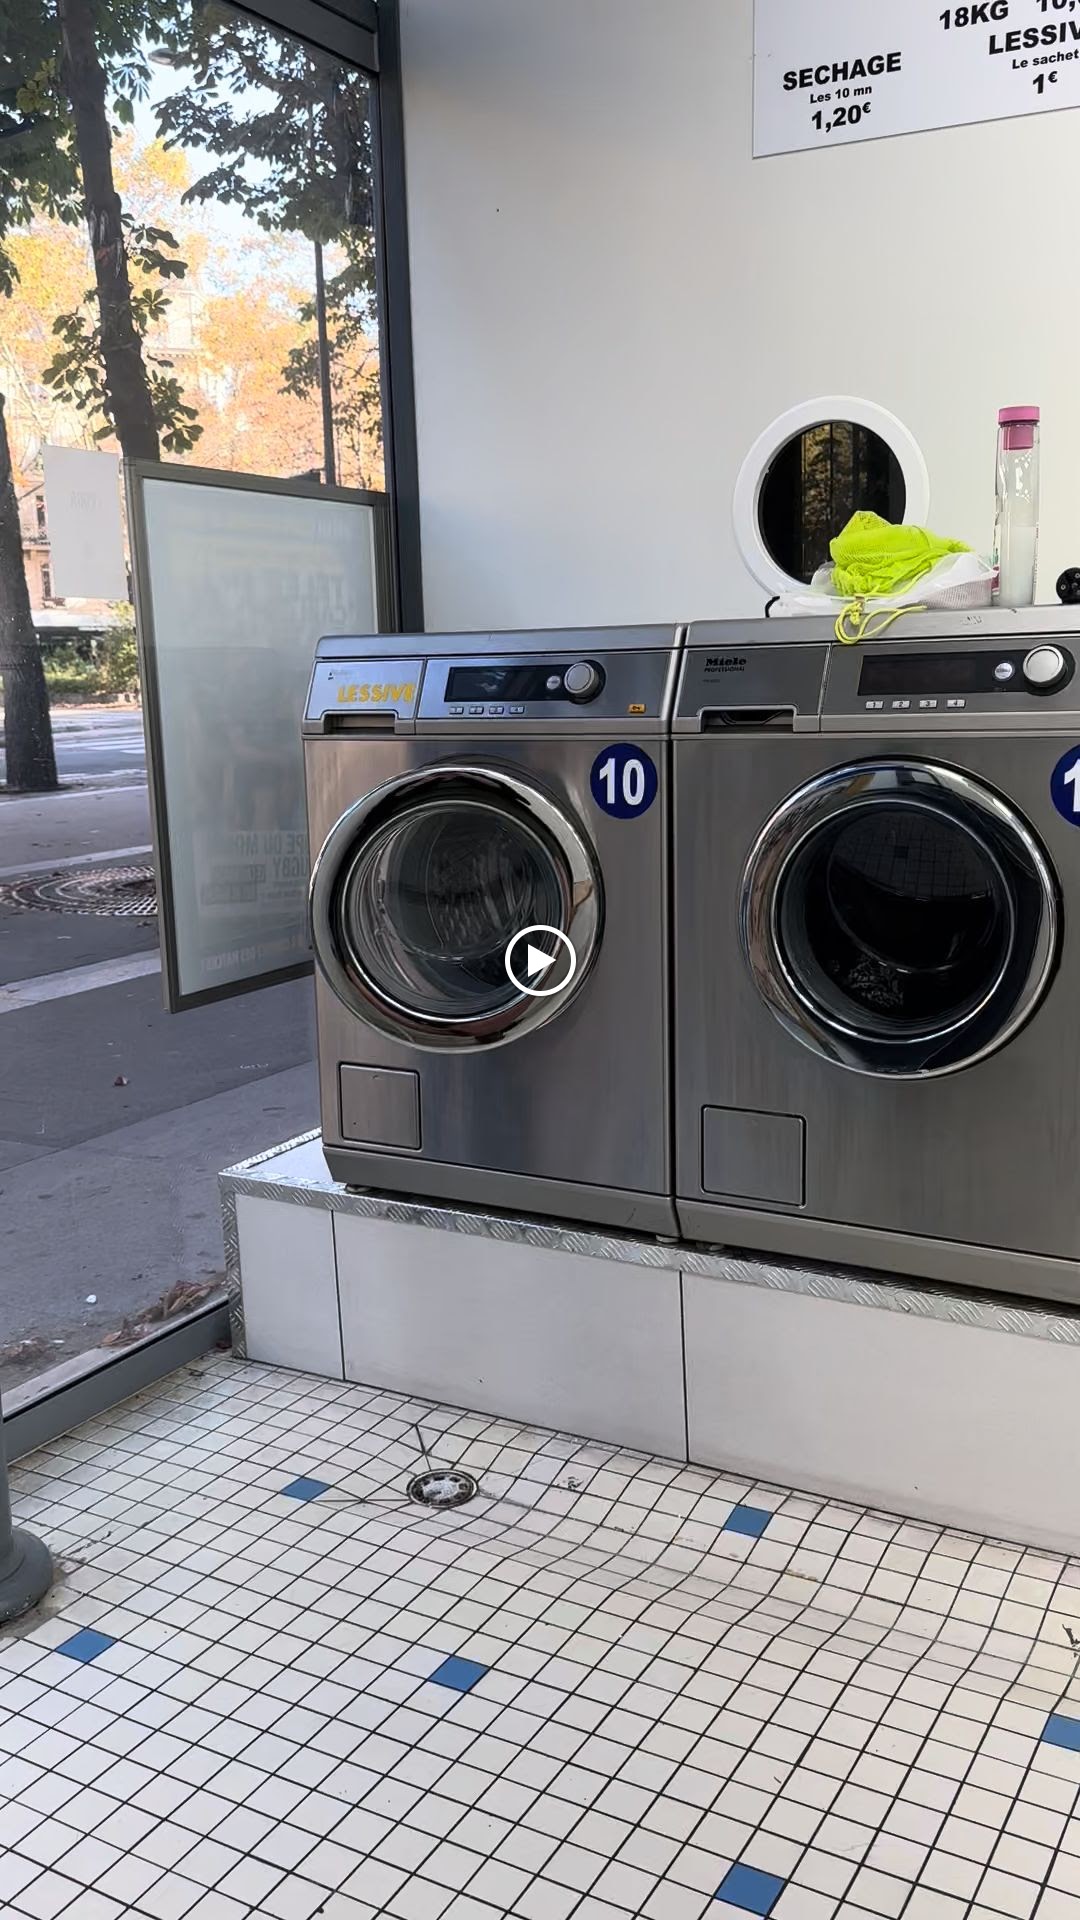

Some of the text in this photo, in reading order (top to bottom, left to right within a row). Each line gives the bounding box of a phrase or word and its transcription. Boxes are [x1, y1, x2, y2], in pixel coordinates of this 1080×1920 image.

[939, 0, 1080, 30] 18KG 10,
[988, 20, 1080, 55] LESSIV
[782, 51, 902, 91] SECHAGE
[1012, 48, 1079, 70] Le sachet
[809, 84, 873, 104] Les 10 mn
[1032, 70, 1058, 94] 1€
[811, 101, 872, 133] 1,20€
[705, 657, 747, 667] Miele
[598, 758, 646, 806] 10
